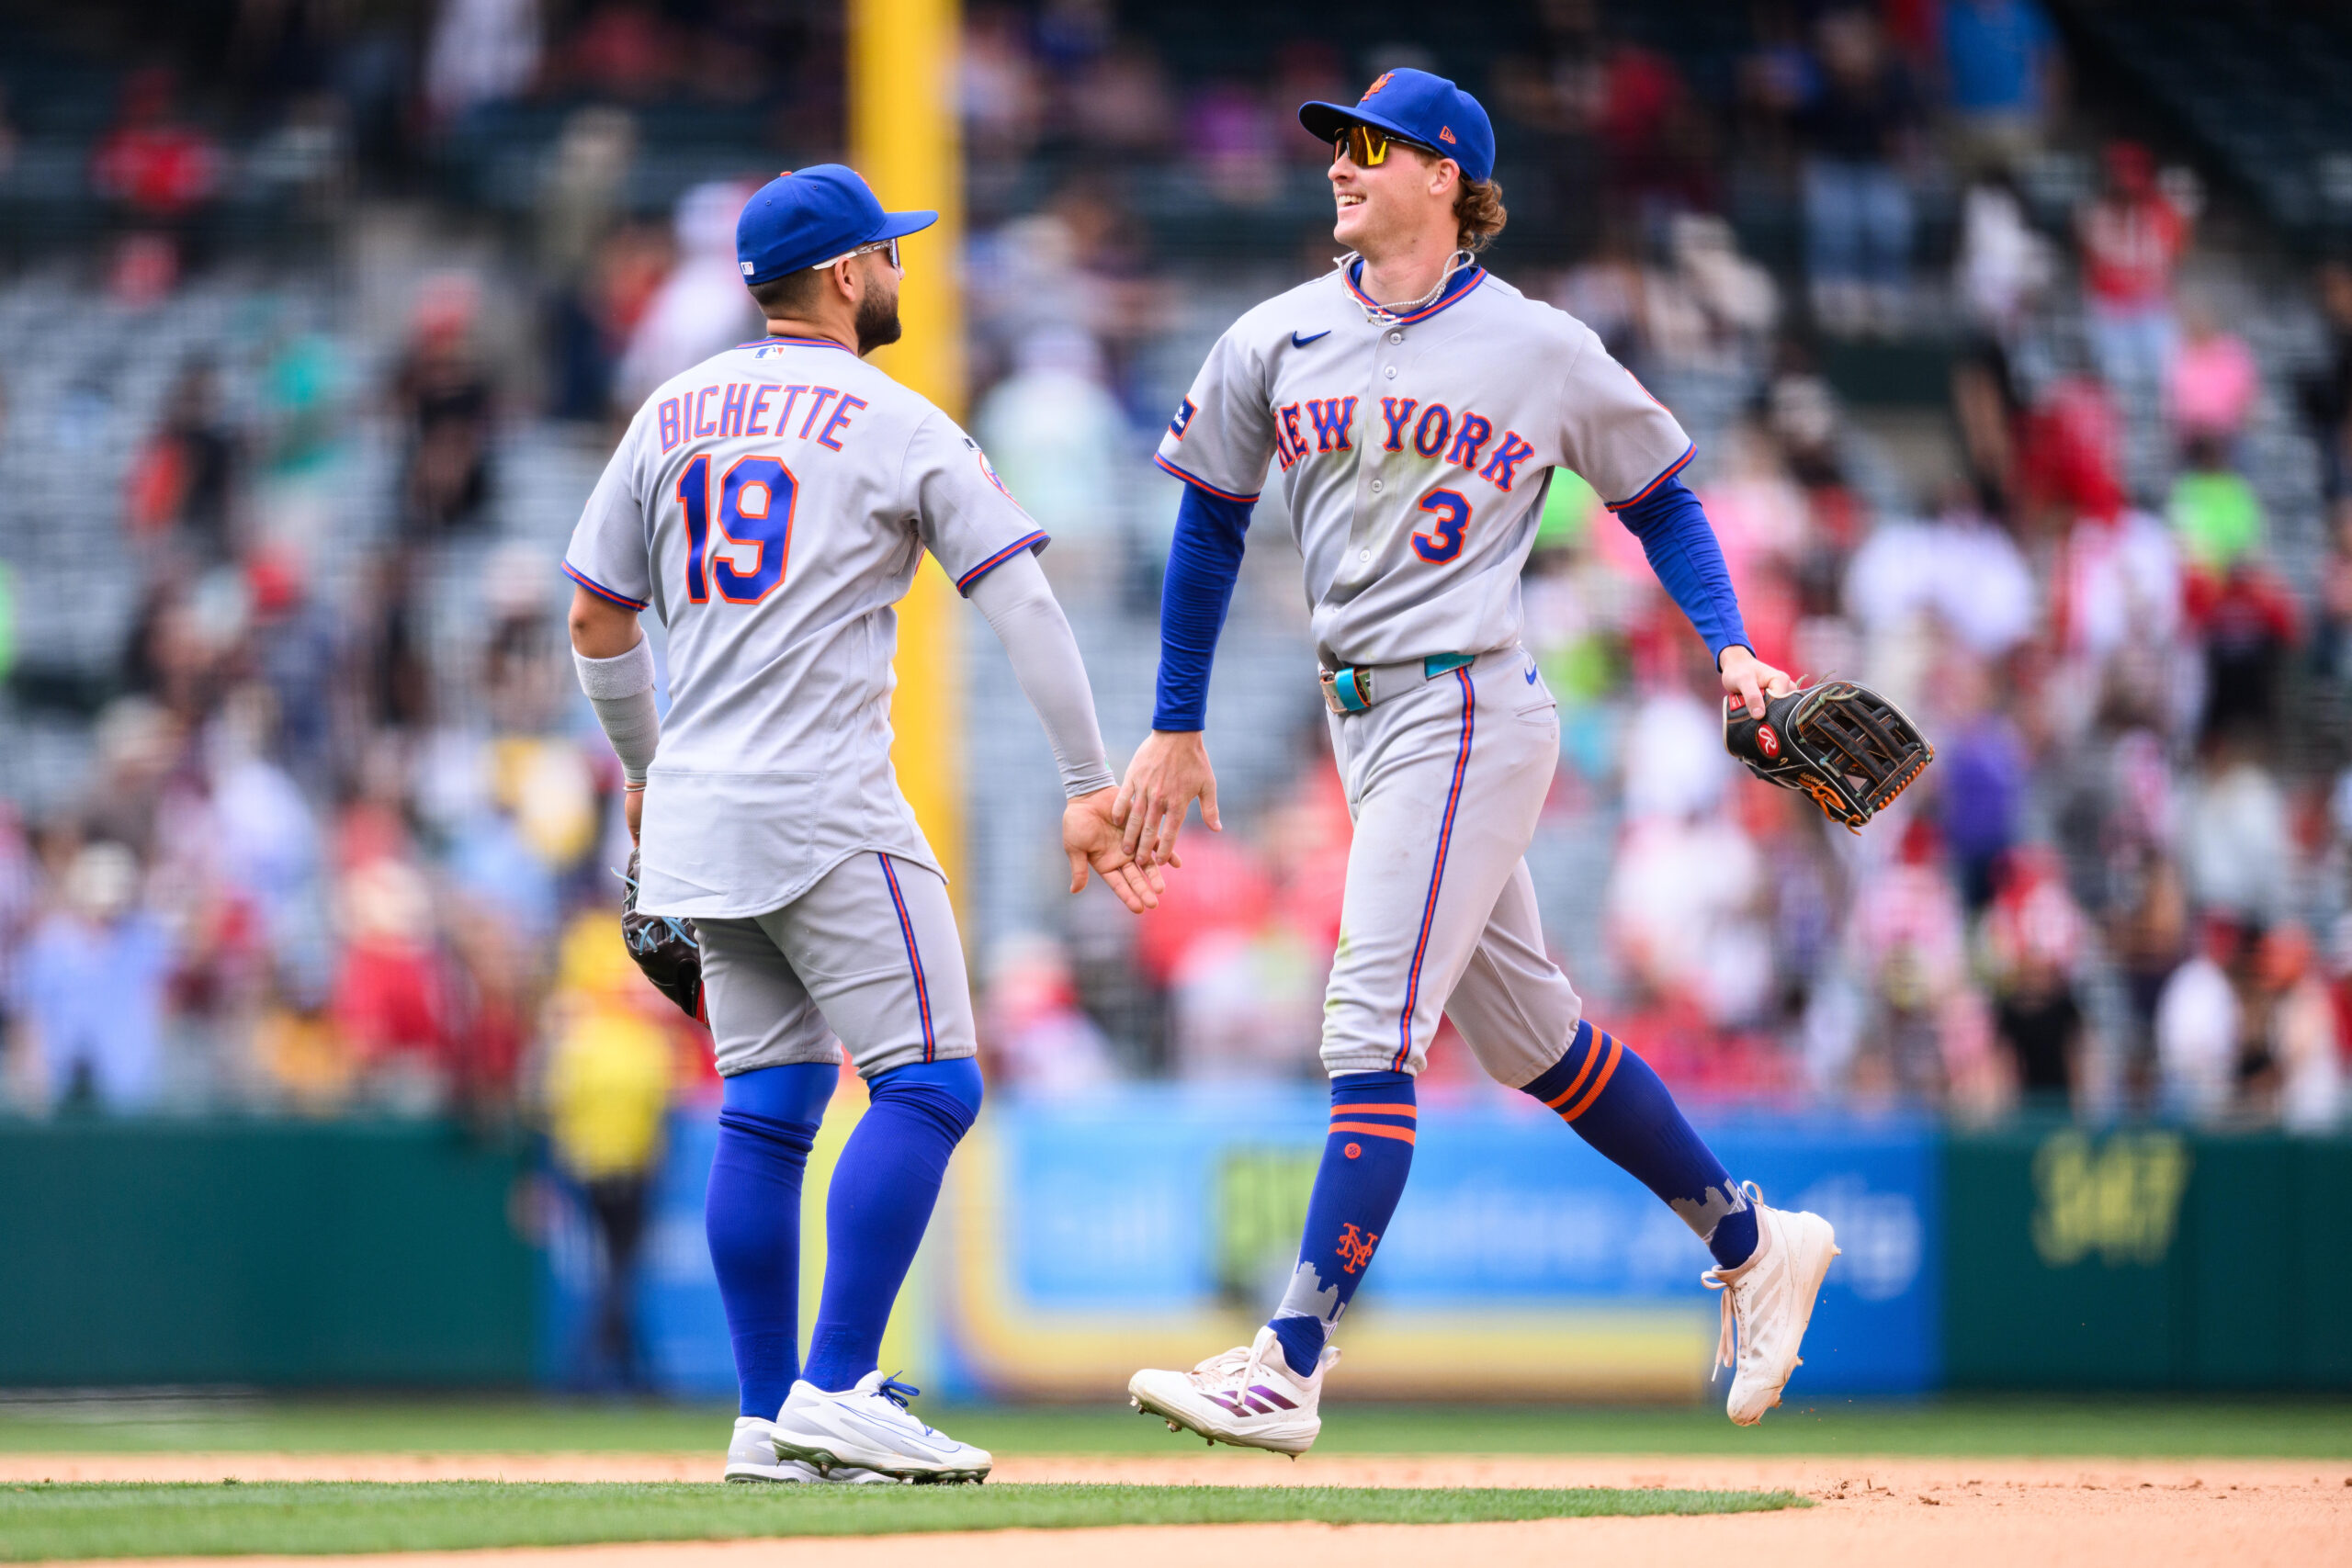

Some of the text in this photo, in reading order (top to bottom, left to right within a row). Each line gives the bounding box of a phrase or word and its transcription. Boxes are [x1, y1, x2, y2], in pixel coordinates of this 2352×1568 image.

[659, 383, 868, 455] BICHETTE
[1380, 397, 1534, 492] YORK
[676, 454, 799, 605] 19
[1410, 488, 1473, 565] 3
[1335, 1223, 1378, 1274] NY
